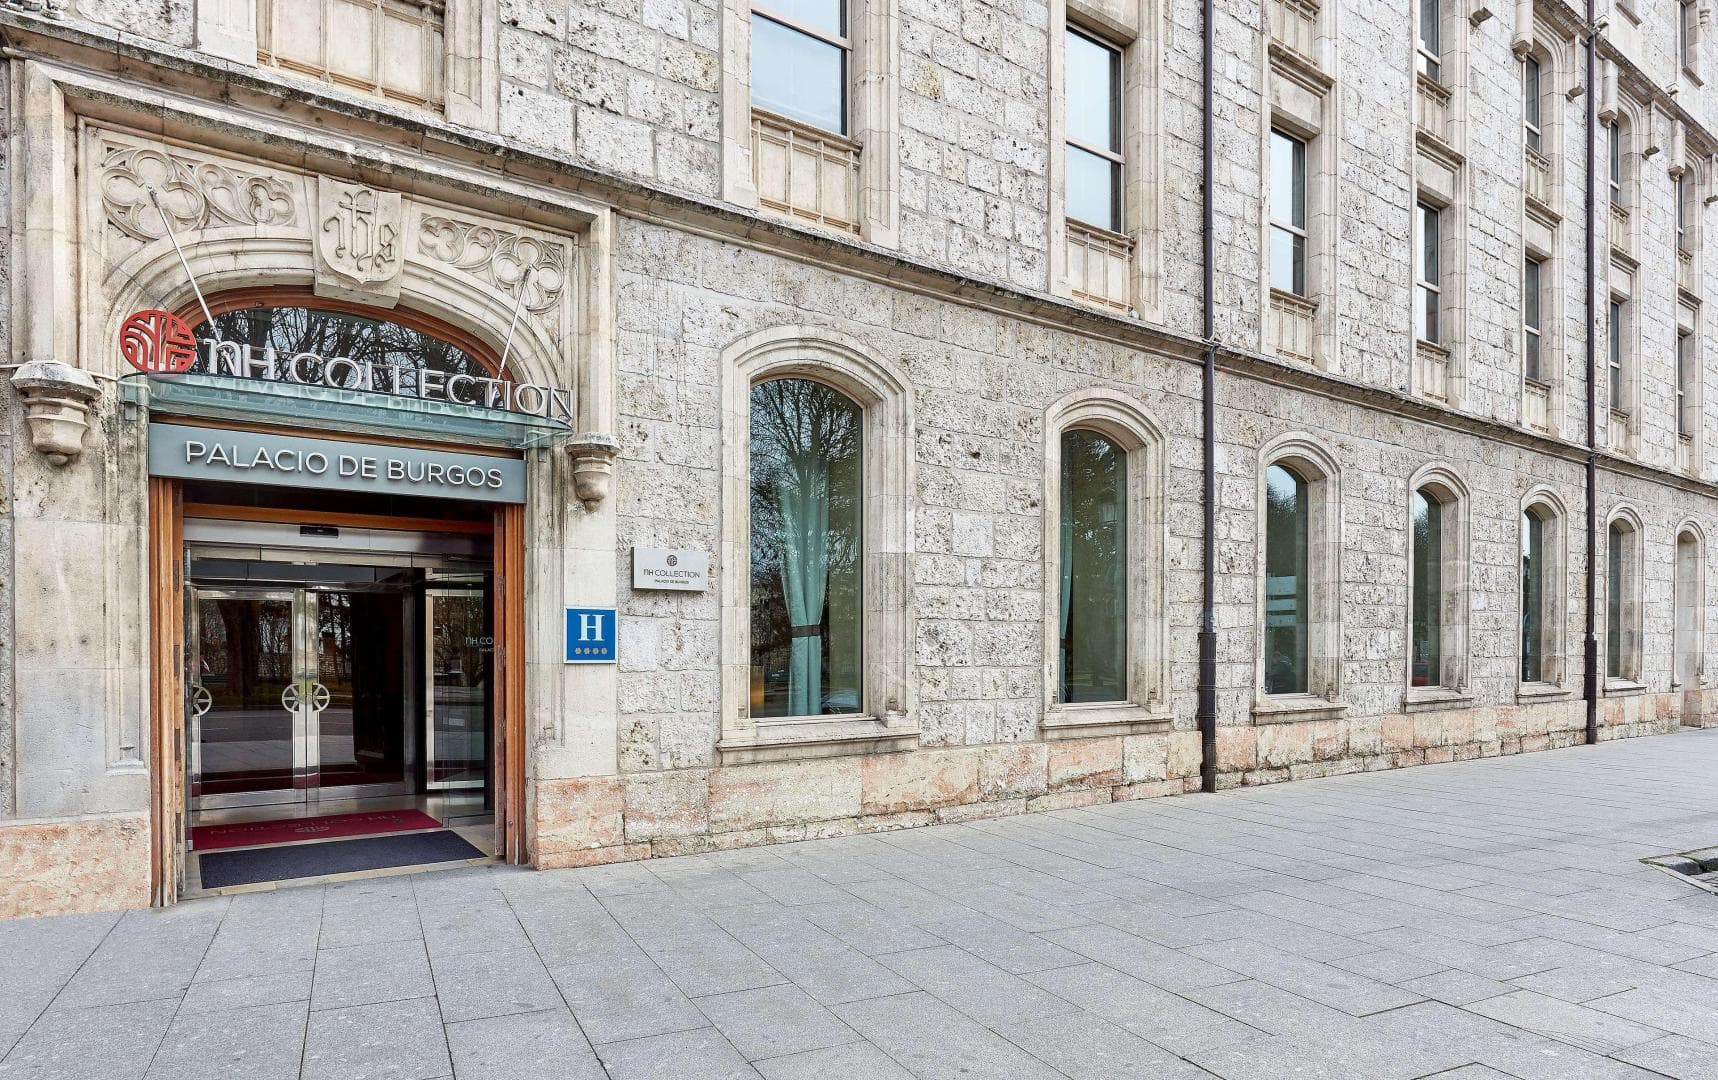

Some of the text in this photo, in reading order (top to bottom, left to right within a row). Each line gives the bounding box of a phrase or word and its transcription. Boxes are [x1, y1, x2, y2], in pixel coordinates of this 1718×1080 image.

[185, 440, 503, 488] PALACIO DE BURGOS
[654, 569, 701, 578] COLLECTION
[577, 613, 606, 642] H
